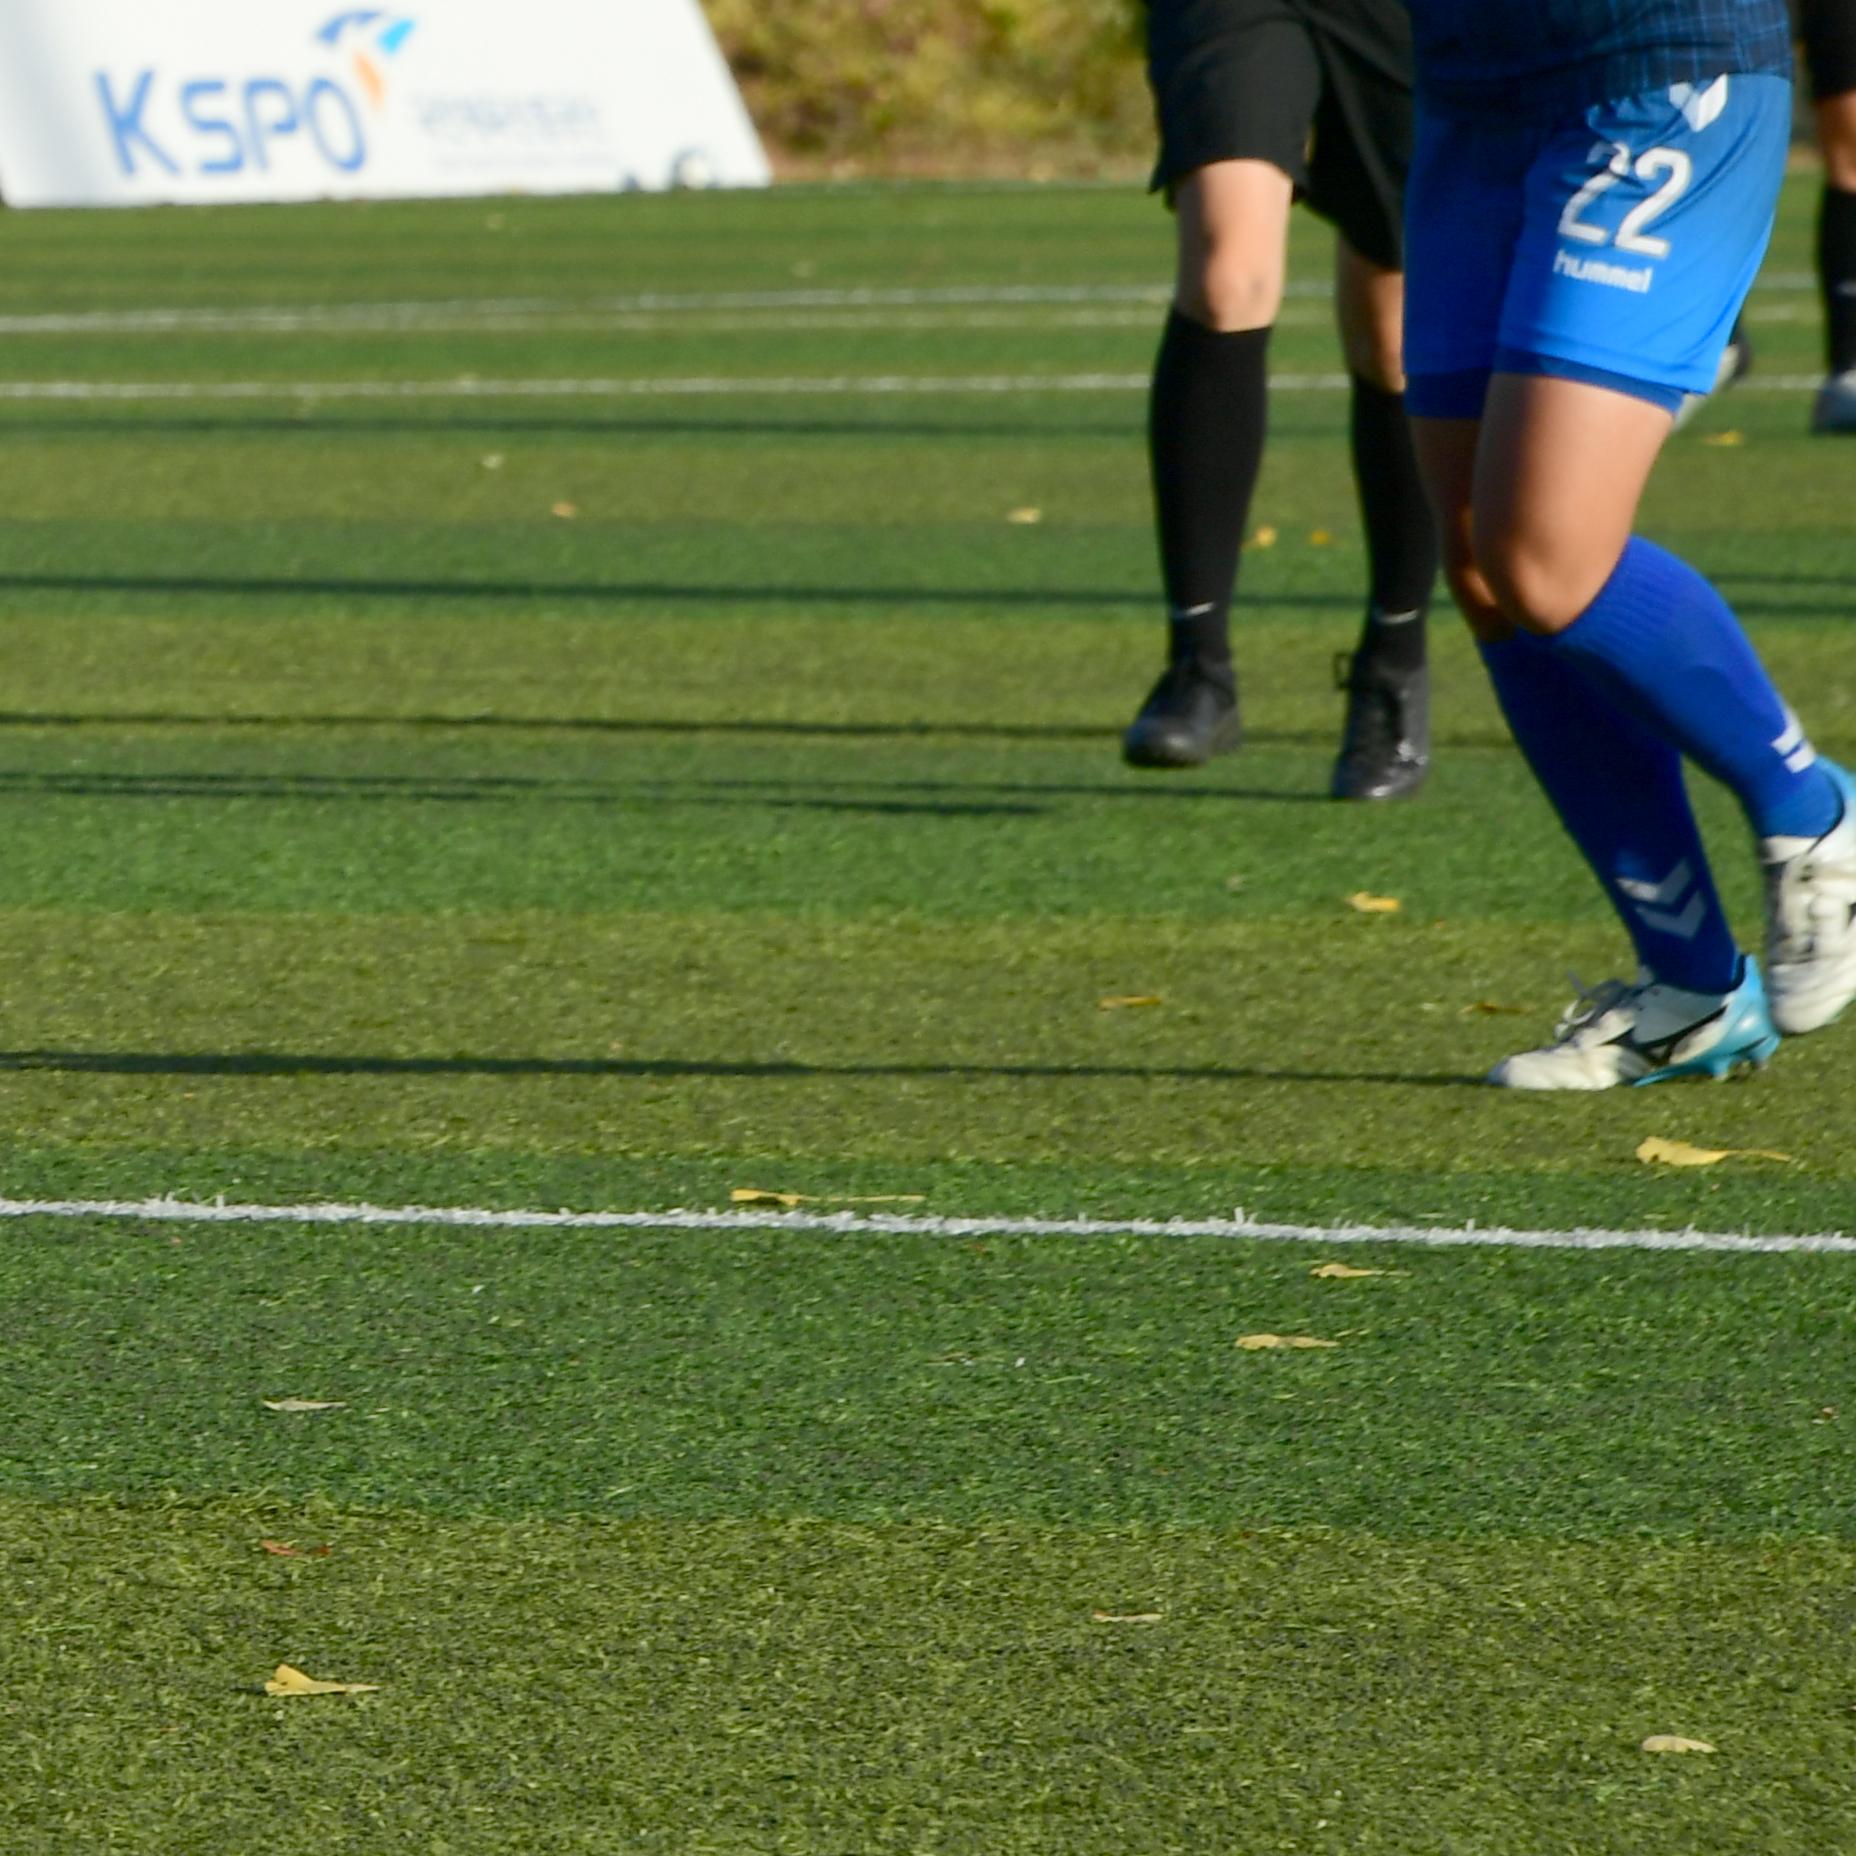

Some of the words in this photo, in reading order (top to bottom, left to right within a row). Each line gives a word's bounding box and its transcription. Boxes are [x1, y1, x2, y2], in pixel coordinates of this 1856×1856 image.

[94, 68, 366, 175] KSPO
[1558, 142, 1692, 260] 22
[1552, 250, 1653, 293] hummel
